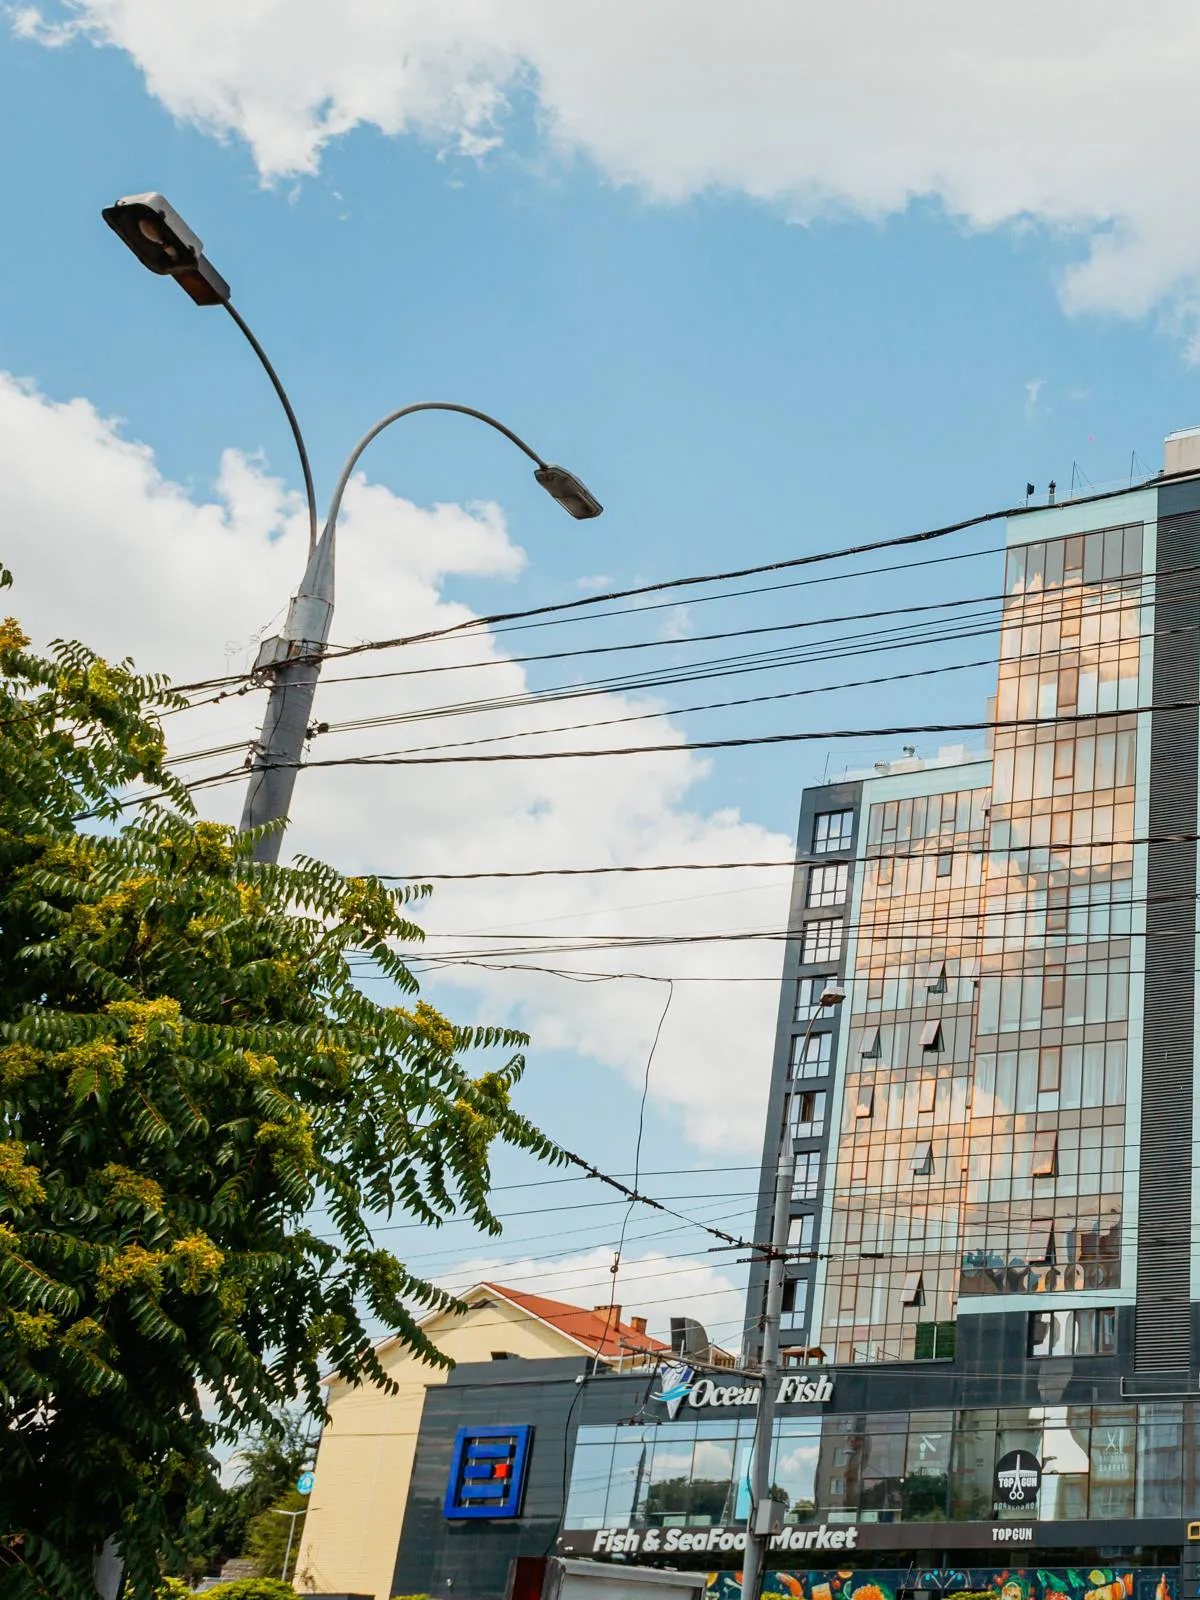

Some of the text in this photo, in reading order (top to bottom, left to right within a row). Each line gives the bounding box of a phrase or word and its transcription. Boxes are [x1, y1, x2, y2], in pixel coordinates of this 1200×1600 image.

[775, 1375, 834, 1404] Fish
[998, 1477, 1038, 1488] TOP GUN
[593, 1524, 859, 1552] Fish & SeaFoo Market
